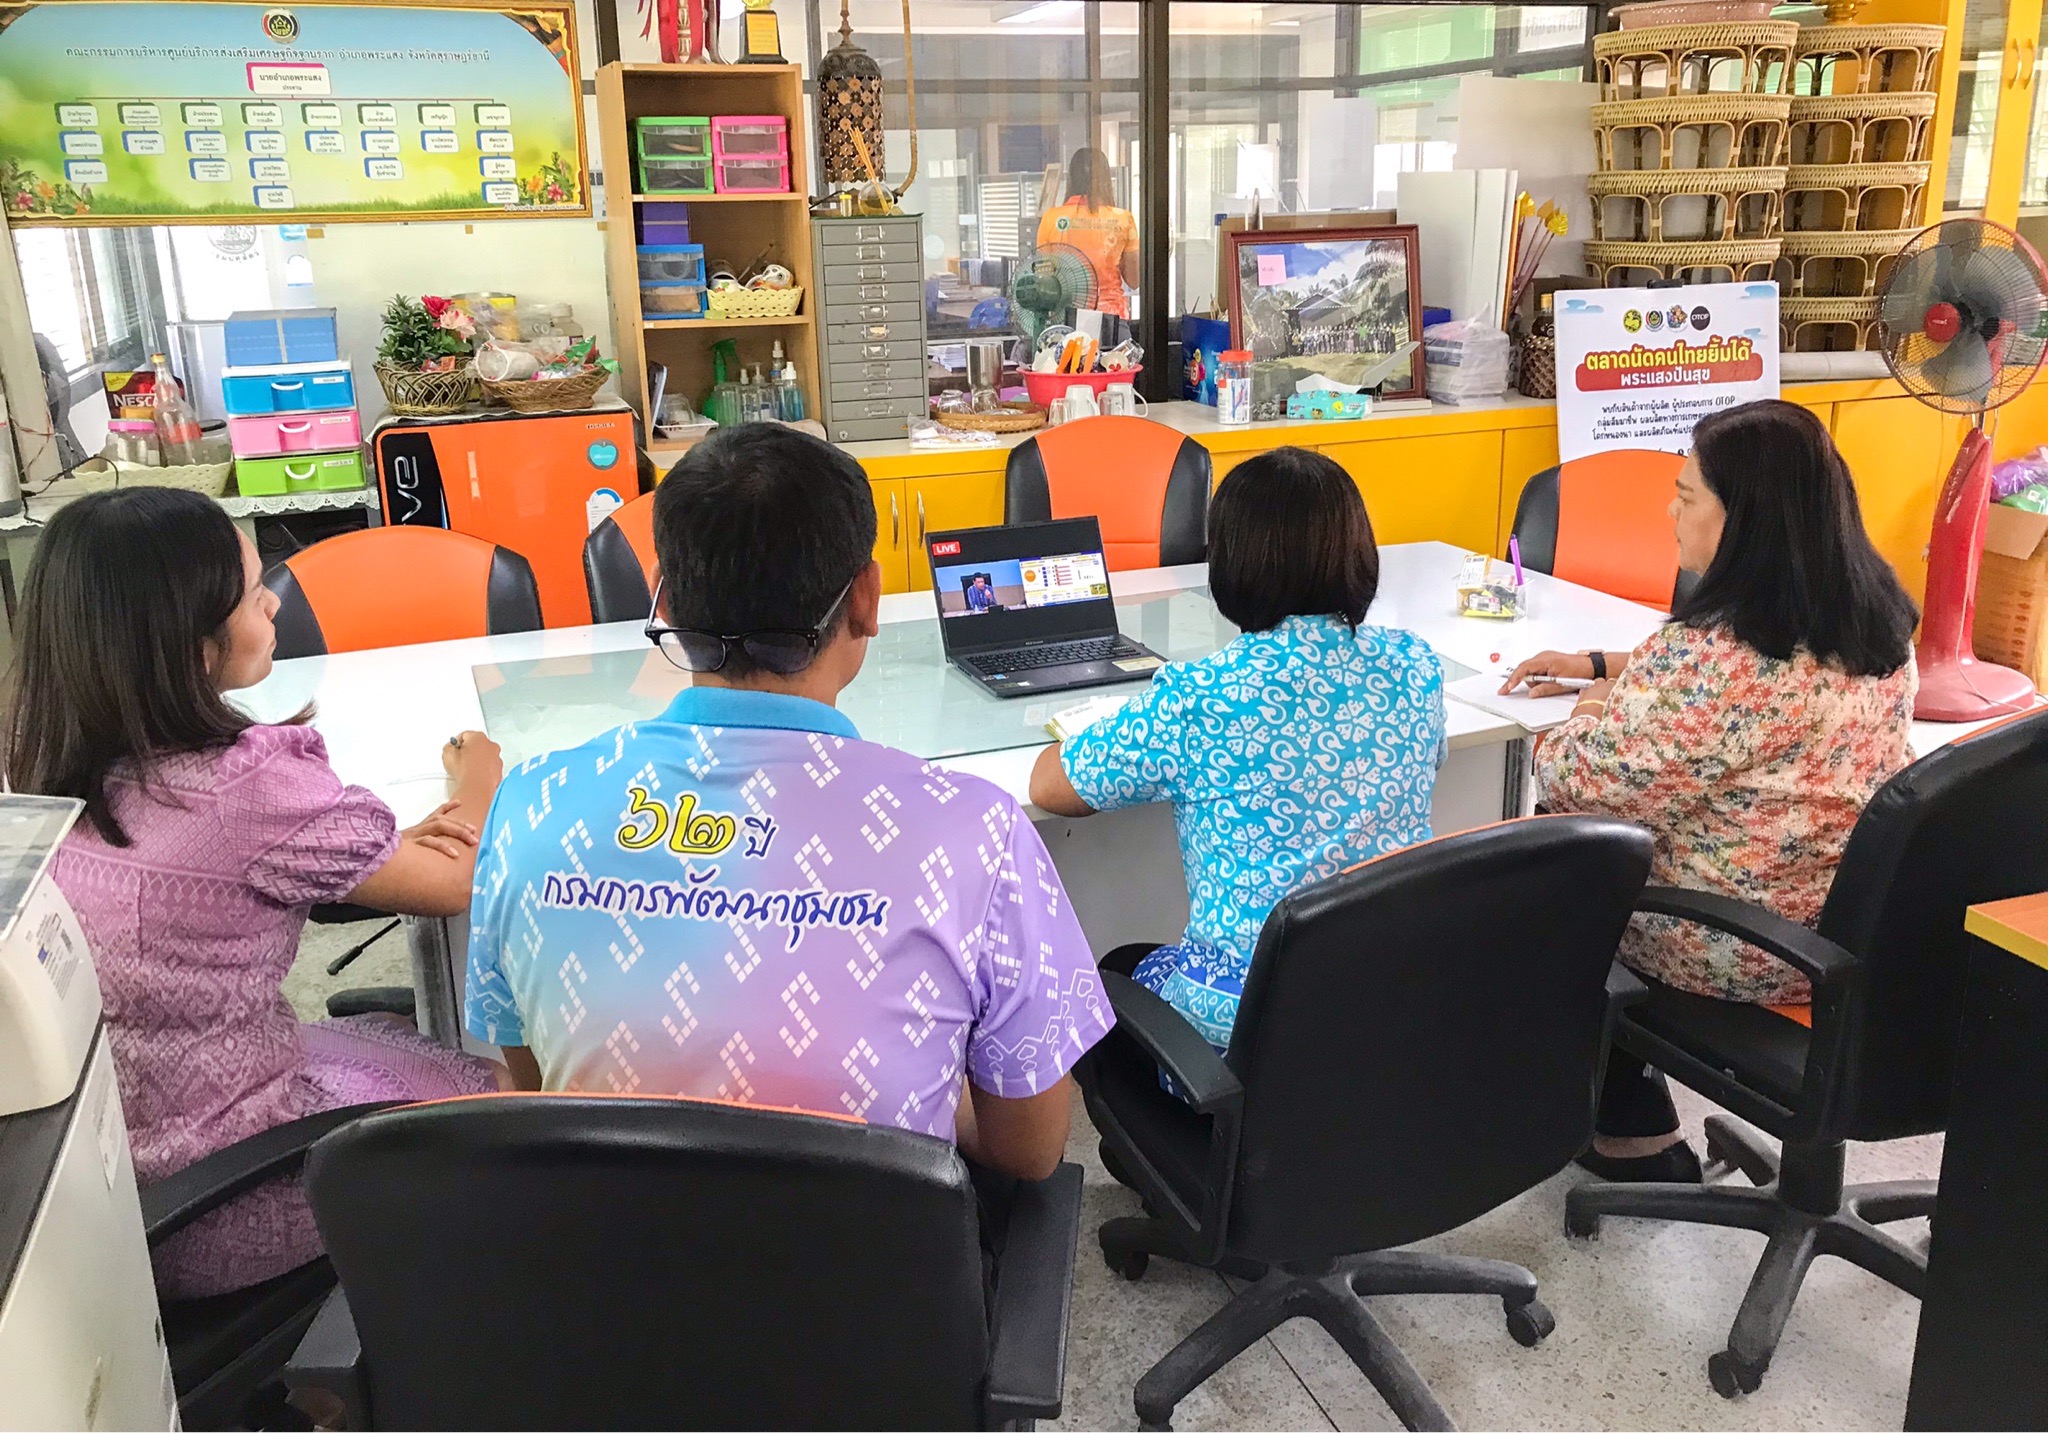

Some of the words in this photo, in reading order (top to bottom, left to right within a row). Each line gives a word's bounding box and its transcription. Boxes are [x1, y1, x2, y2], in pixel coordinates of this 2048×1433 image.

[339, 49, 404, 60] อำเภอพระแสง
[1691, 313, 1709, 321] OTOP
[1586, 340, 1750, 370] ตลาดนัดคนไทยยิ้มได้
[1620, 365, 1711, 387] พระแสงปันสุข
[1602, 400, 1670, 414] พบกับสินค้าจากผู้ผลิต
[1672, 398, 1713, 412] ผู้ประกอบการ
[1715, 395, 1736, 407] OTOP
[936, 544, 957, 554] LIVE
[617, 787, 737, 856] ๖๒
[744, 815, 776, 859] ปี
[543, 868, 888, 949] กรมการพัฒนาชุมชน
